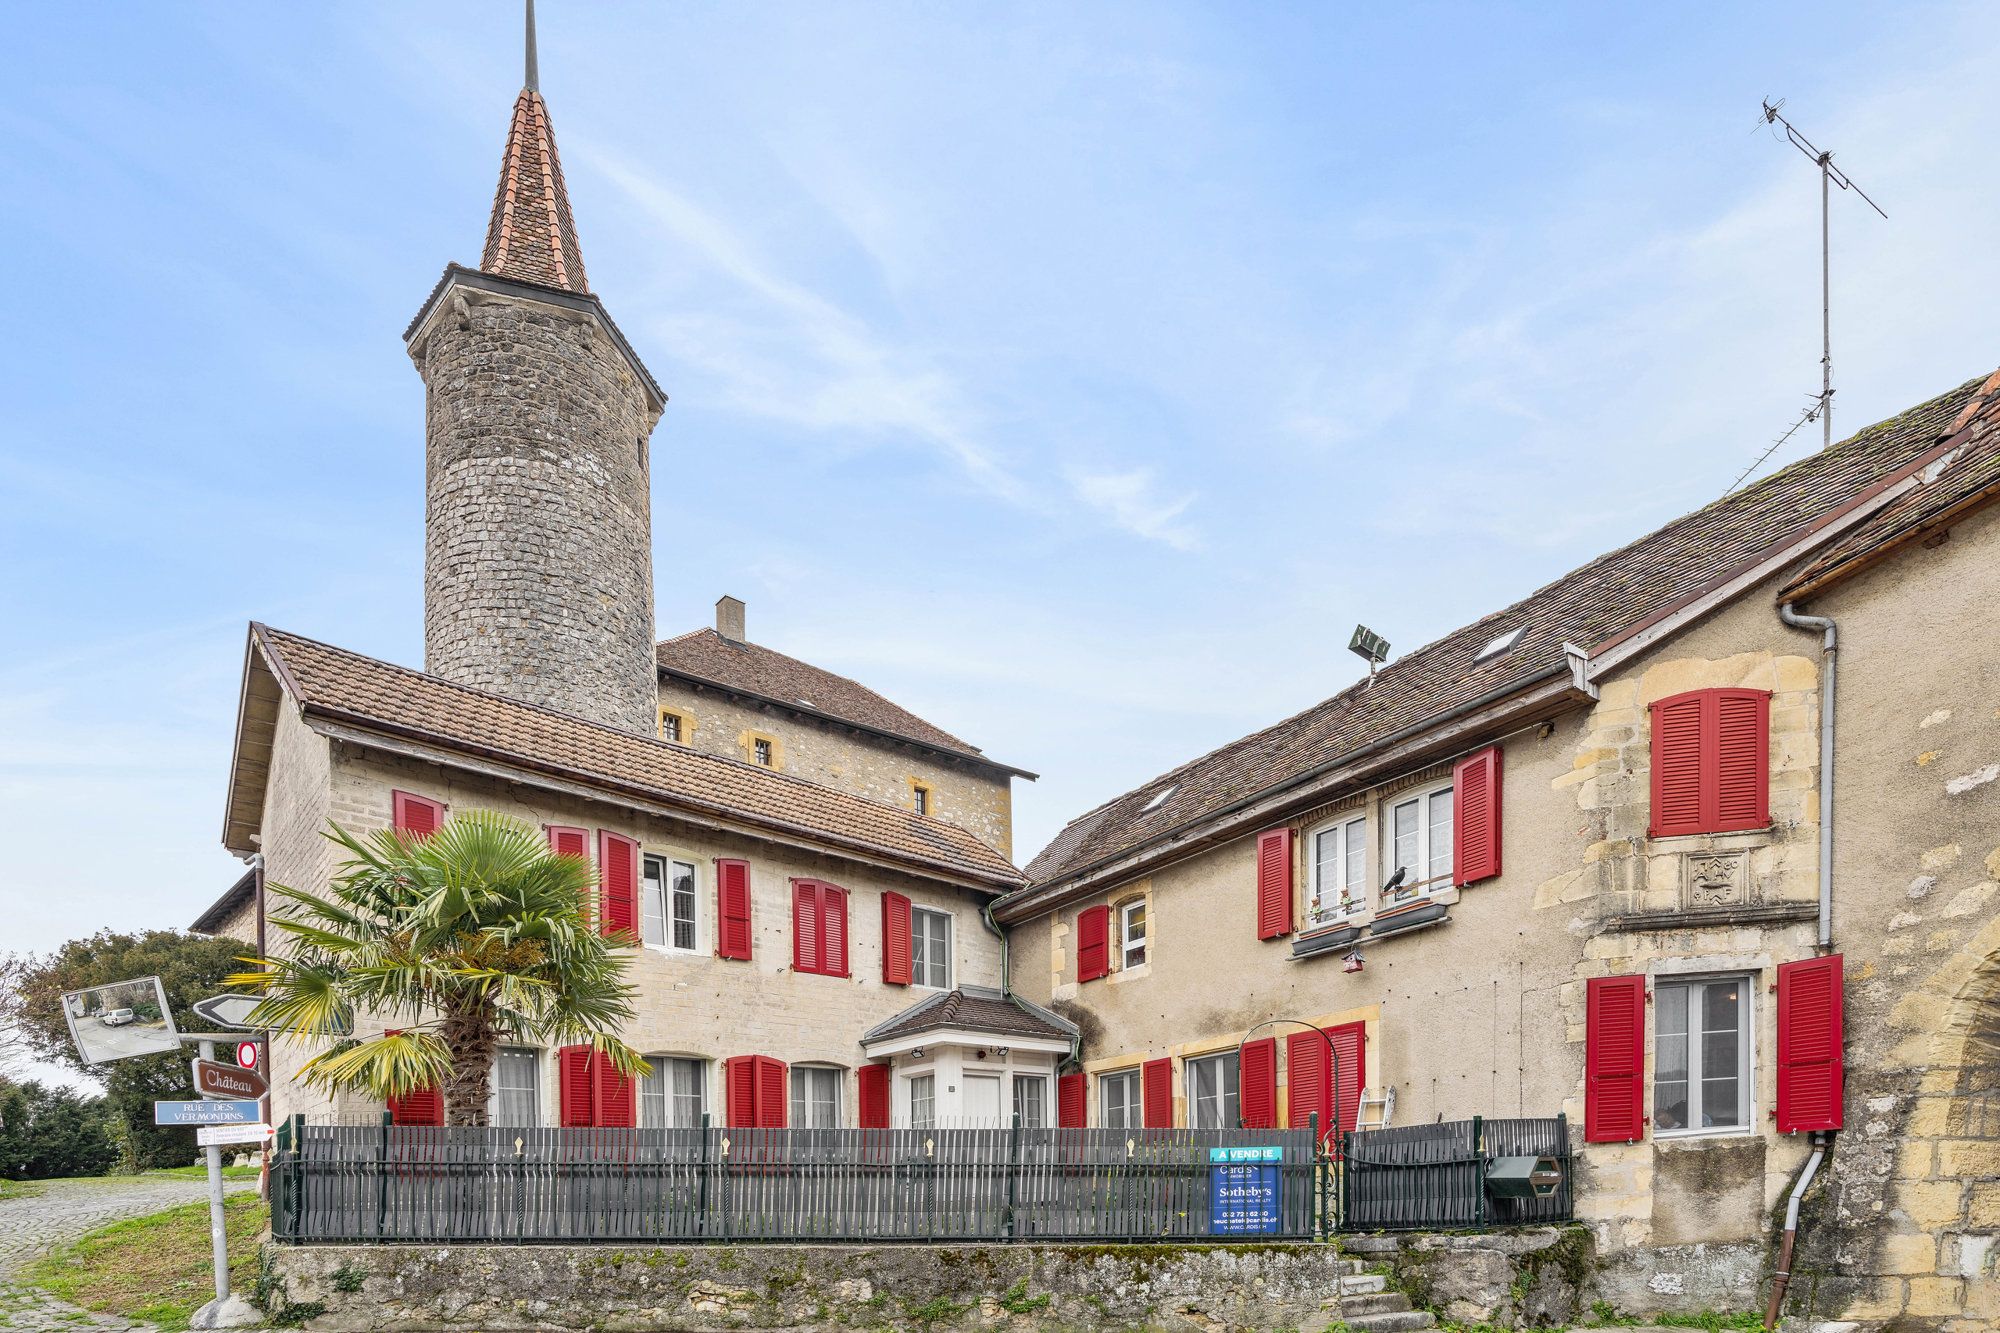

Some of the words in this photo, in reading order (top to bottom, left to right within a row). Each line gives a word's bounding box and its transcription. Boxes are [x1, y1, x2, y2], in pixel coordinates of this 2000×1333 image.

[205, 1069, 253, 1093] Château
[183, 1103, 205, 1112] RUE
[213, 1103, 234, 1112] DES
[174, 1112, 244, 1121] VERMONDINS
[1218, 1150, 1227, 1159] A
[1230, 1149, 1274, 1159] VENDRE
[1219, 1165, 1253, 1175] Cards
[1219, 1186, 1272, 1199] Sotheby's
